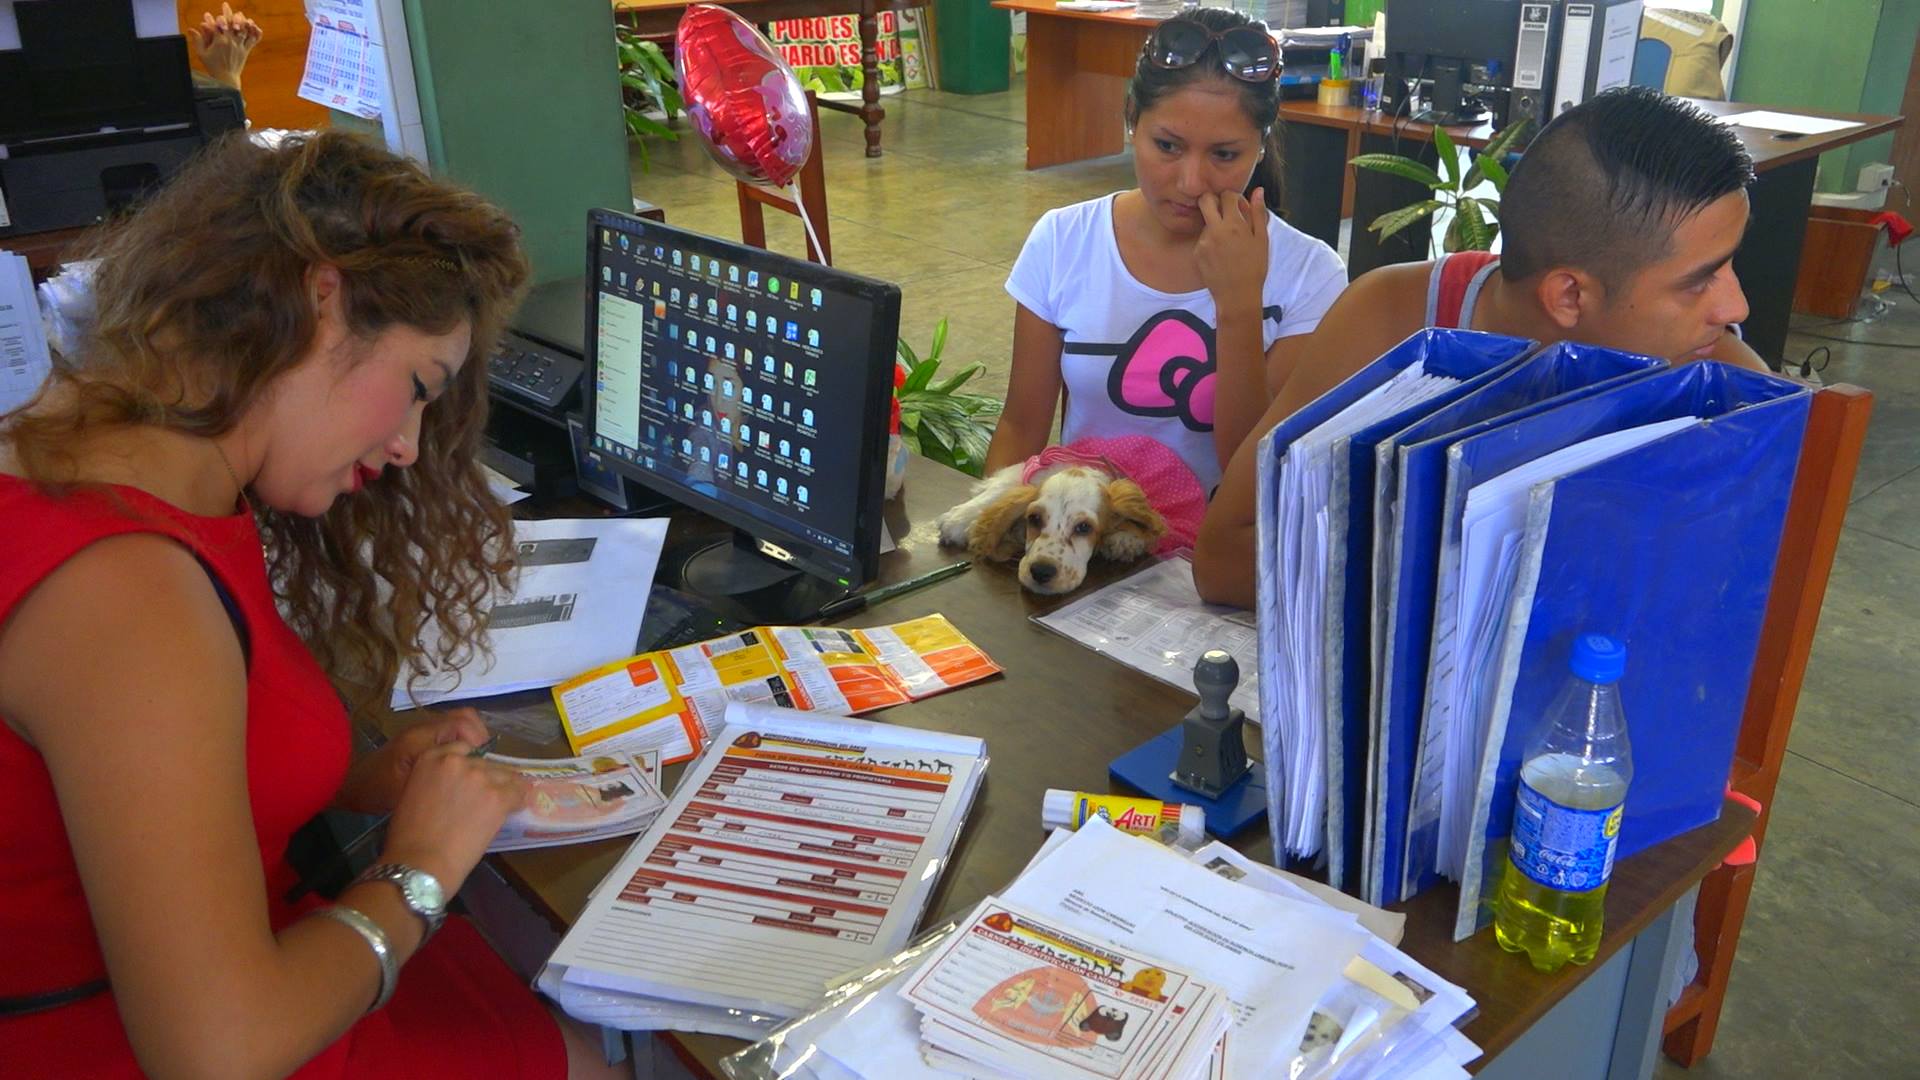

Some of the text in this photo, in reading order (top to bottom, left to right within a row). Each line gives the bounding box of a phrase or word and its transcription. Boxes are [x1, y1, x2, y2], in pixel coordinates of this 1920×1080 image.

[775, 16, 853, 40] PURO ES
[840, 43, 861, 65] ES
[976, 927, 1009, 946] CARNET
[1086, 970, 1120, 988] CANINO
